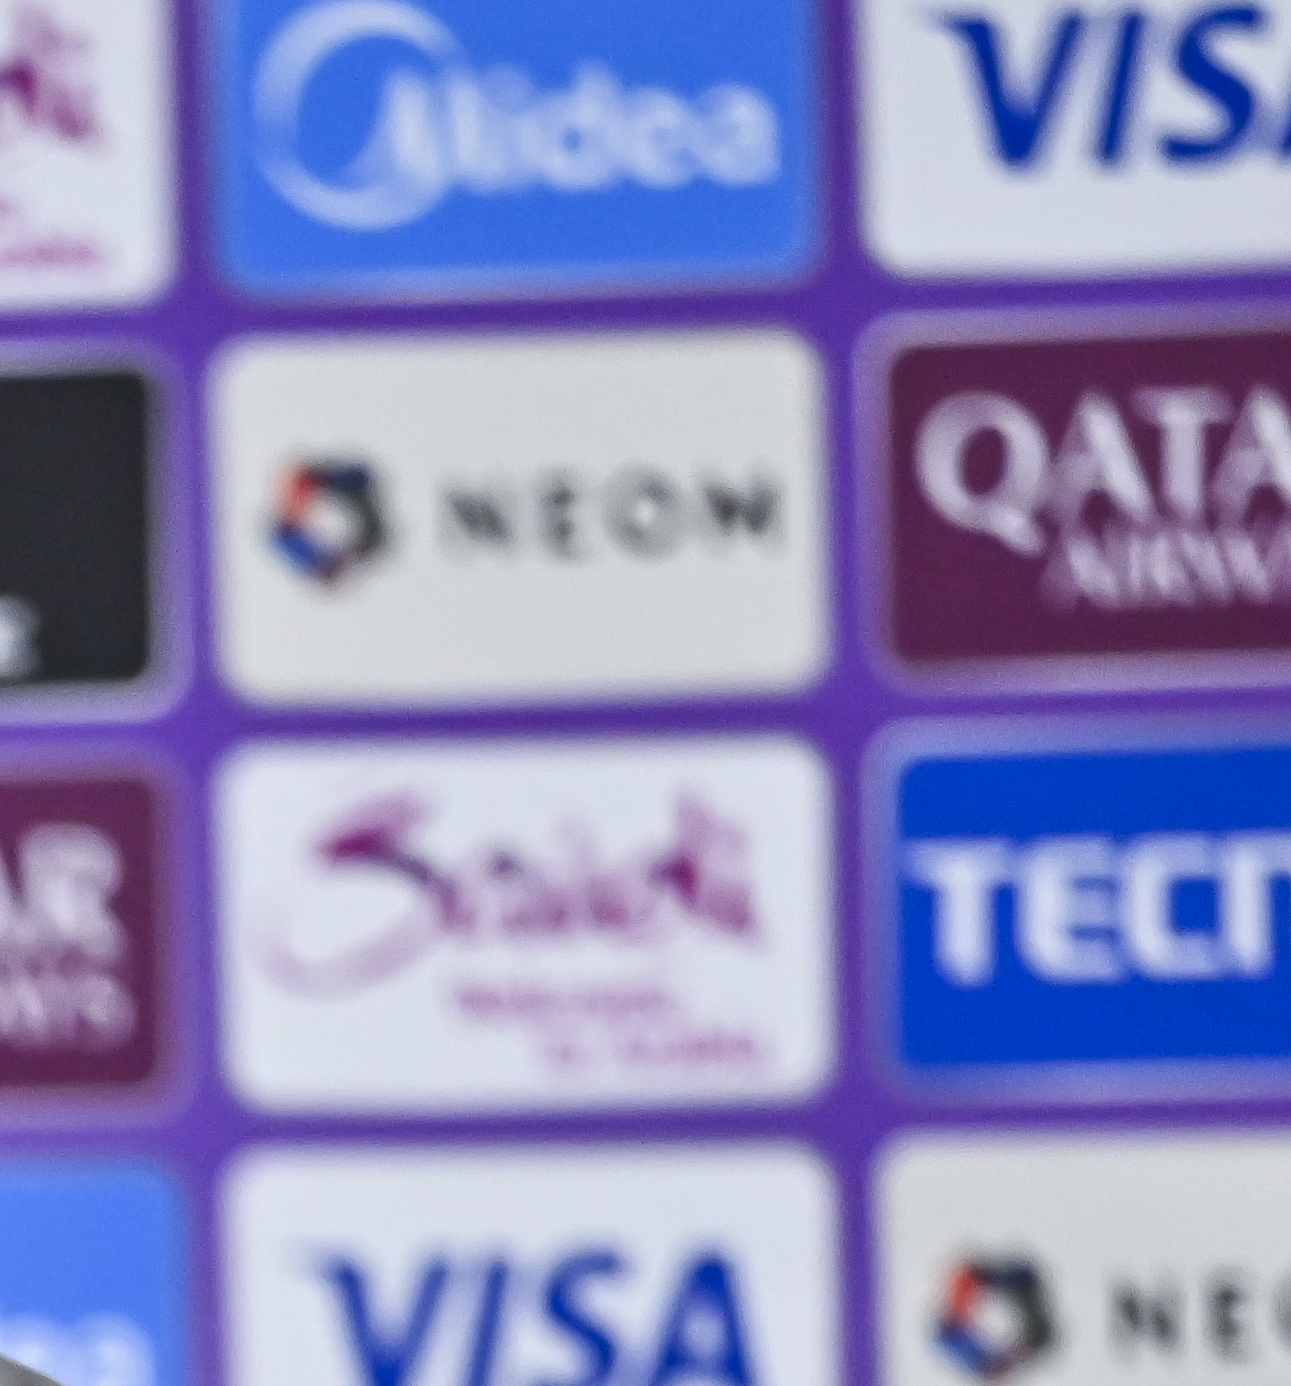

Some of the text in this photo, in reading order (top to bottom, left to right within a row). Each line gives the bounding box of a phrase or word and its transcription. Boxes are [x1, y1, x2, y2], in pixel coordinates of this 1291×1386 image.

[940, 3, 1291, 172] VIS
[915, 383, 1291, 556] QATA
[907, 830, 1291, 985] TECN
[1110, 1268, 1291, 1364] NE
